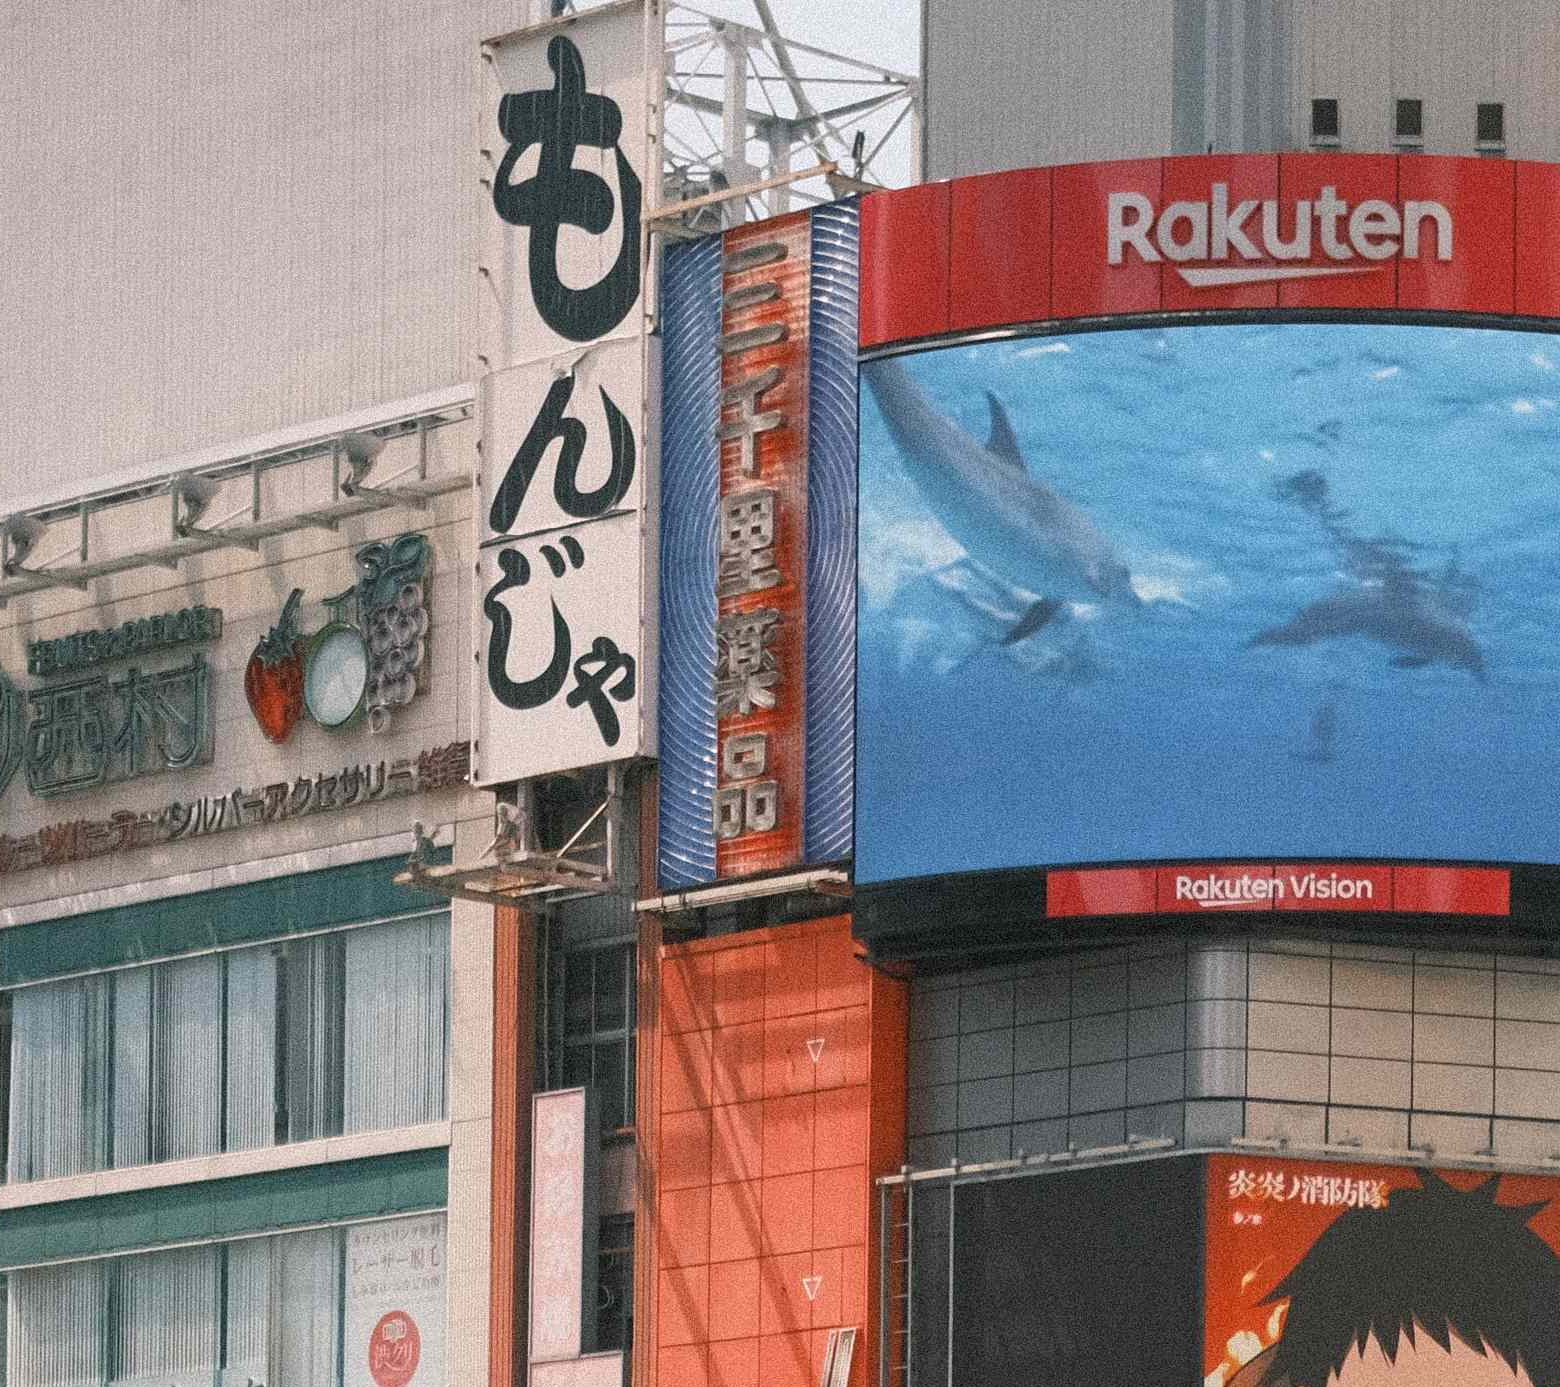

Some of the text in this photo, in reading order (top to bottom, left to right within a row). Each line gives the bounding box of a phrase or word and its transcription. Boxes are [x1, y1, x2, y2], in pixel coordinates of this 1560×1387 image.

[1107, 184, 1453, 266] Rakuten
[484, 35, 641, 745] もんじゃ
[719, 242, 787, 837] 三千里薬品
[1176, 873, 1373, 903] Rakuten Vision
[1228, 1170, 1391, 1209] 炎炎ノ消防隊
